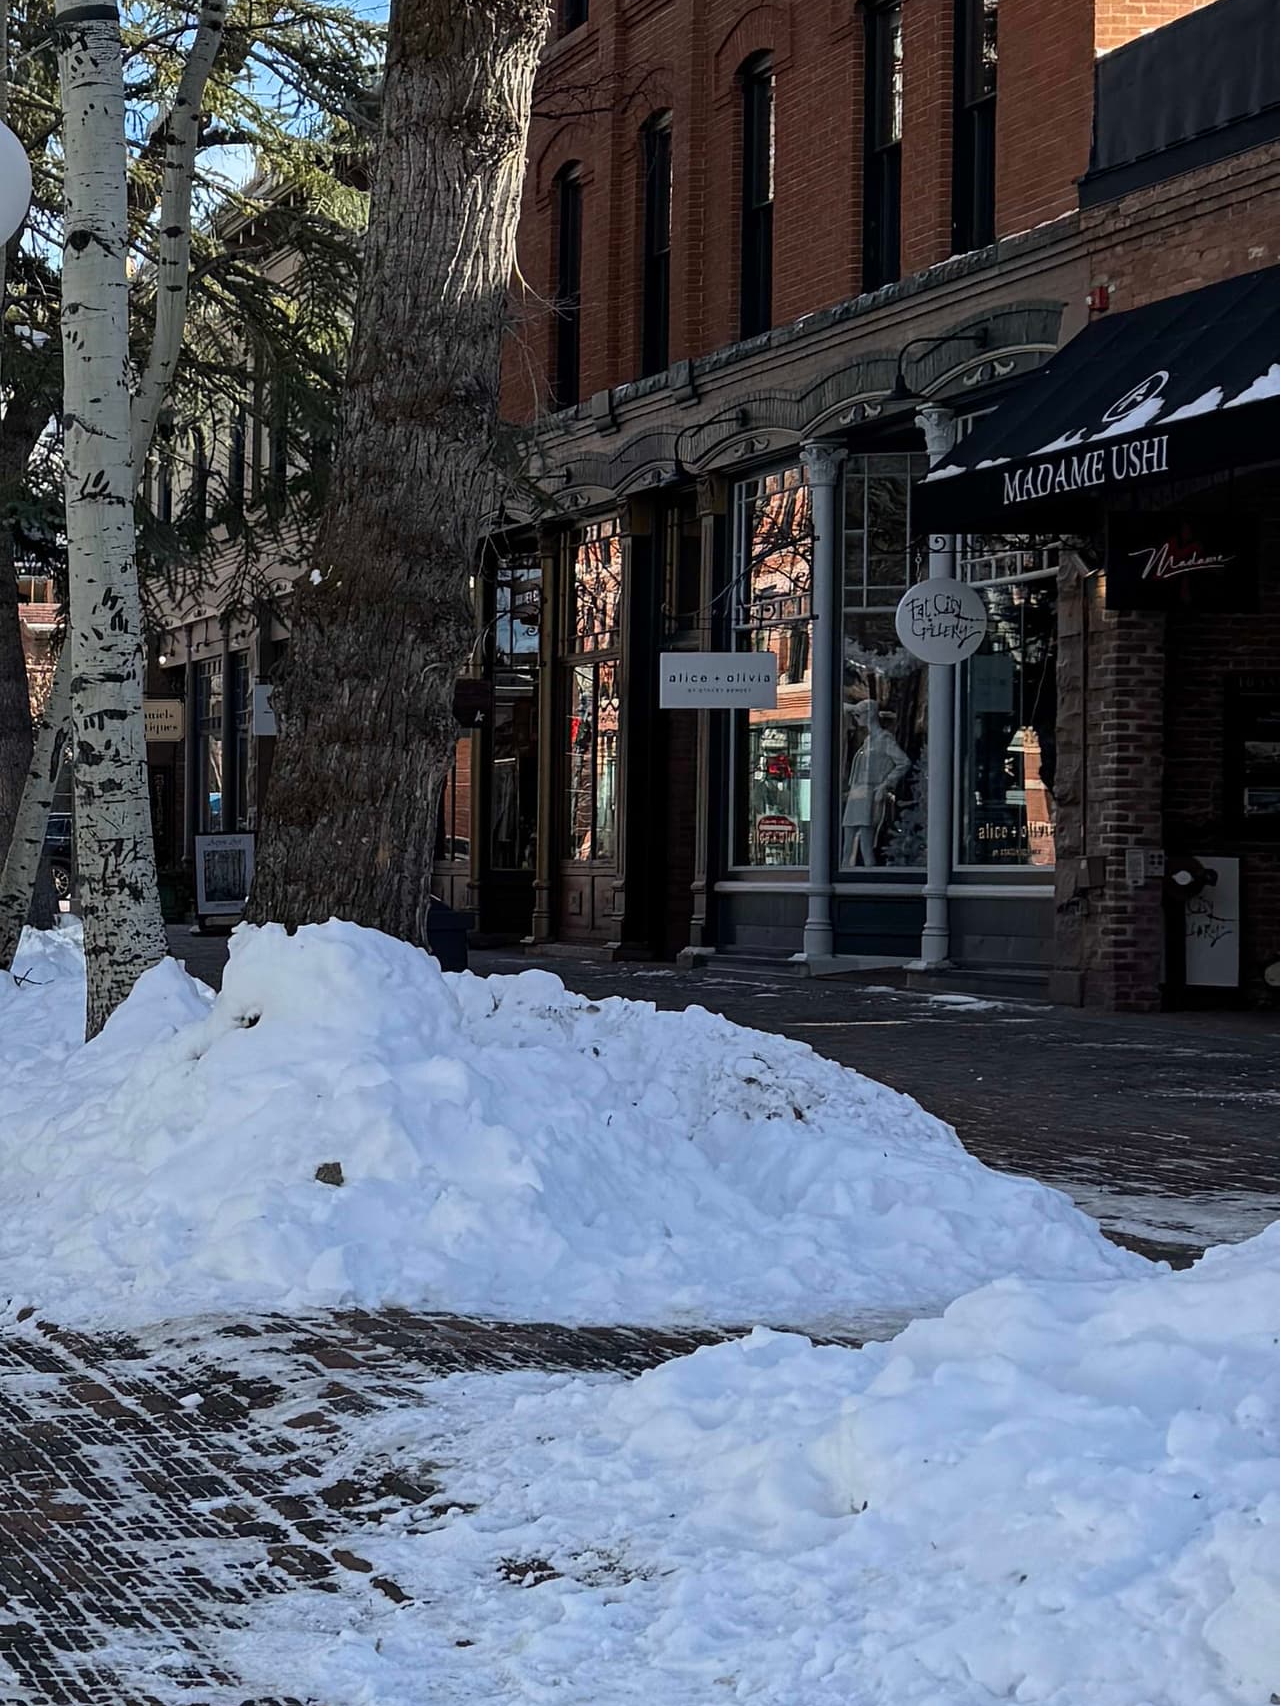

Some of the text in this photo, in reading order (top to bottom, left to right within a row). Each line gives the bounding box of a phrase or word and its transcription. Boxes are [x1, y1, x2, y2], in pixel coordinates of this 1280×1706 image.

[1003, 449, 1105, 506] MADAME
[1111, 435, 1169, 480] USHI
[1127, 542, 1237, 580] Madame
[668, 672, 708, 683] alice
[726, 672, 771, 683] olivia
[978, 822, 1008, 840] alice
